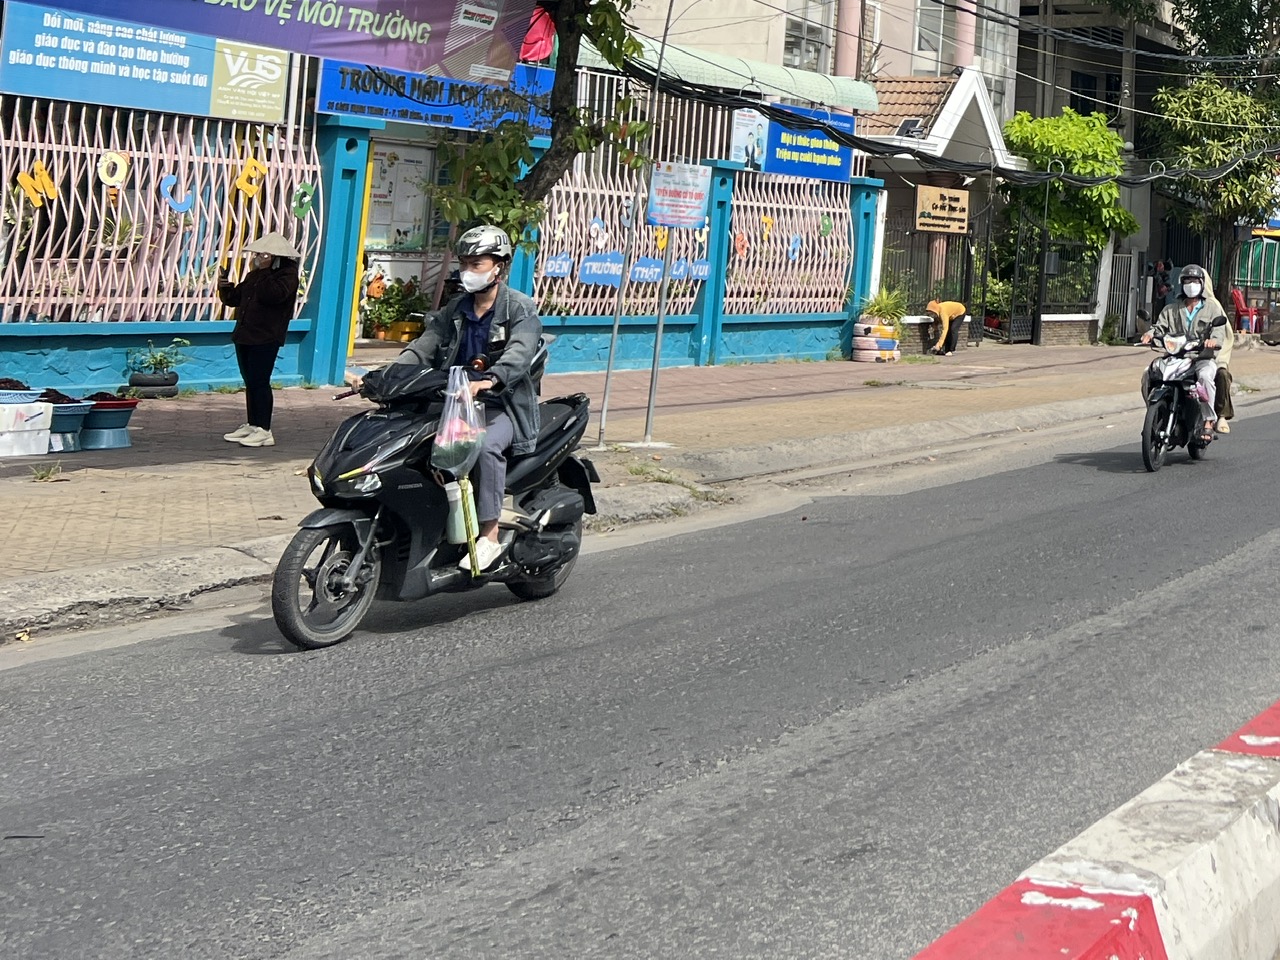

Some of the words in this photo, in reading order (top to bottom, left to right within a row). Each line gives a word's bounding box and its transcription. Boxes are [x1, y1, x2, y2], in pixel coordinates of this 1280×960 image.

[348, 7, 432, 44] TRƯỜNG
[90, 61, 116, 76] minh
[223, 48, 282, 80] VUS
[339, 66, 406, 98] TRƯỜNG
[17, 159, 57, 207] M
[547, 255, 570, 273] ĐẾN
[585, 258, 623, 275] TRƯỜNG
[673, 261, 685, 275] LÀ
[692, 265, 708, 275] VUI
